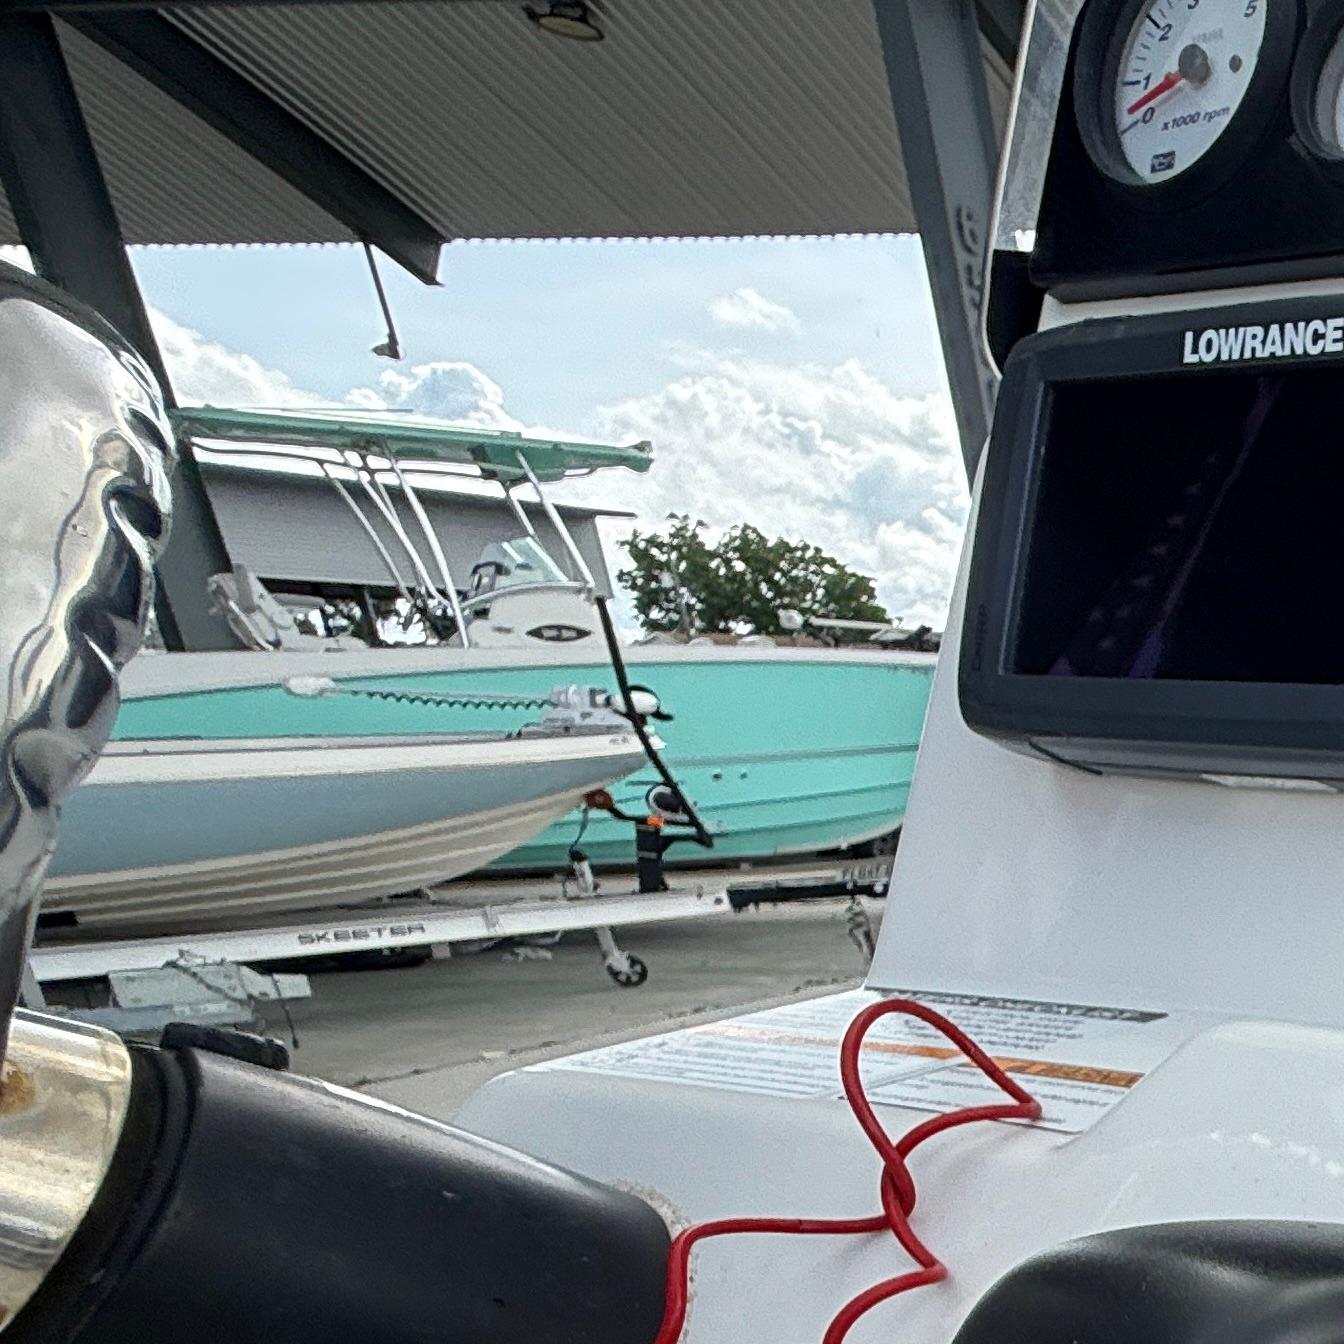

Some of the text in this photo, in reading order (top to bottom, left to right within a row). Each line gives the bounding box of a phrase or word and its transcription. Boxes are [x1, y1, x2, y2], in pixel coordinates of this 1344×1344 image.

[1159, 24, 1172, 41] 2
[1142, 75, 1151, 91] 1
[1142, 107, 1155, 124] 0
[1161, 107, 1230, 131] x1000 rpm
[1183, 318, 1344, 364] LOWRANCE
[298, 922, 425, 944] SKEETER
